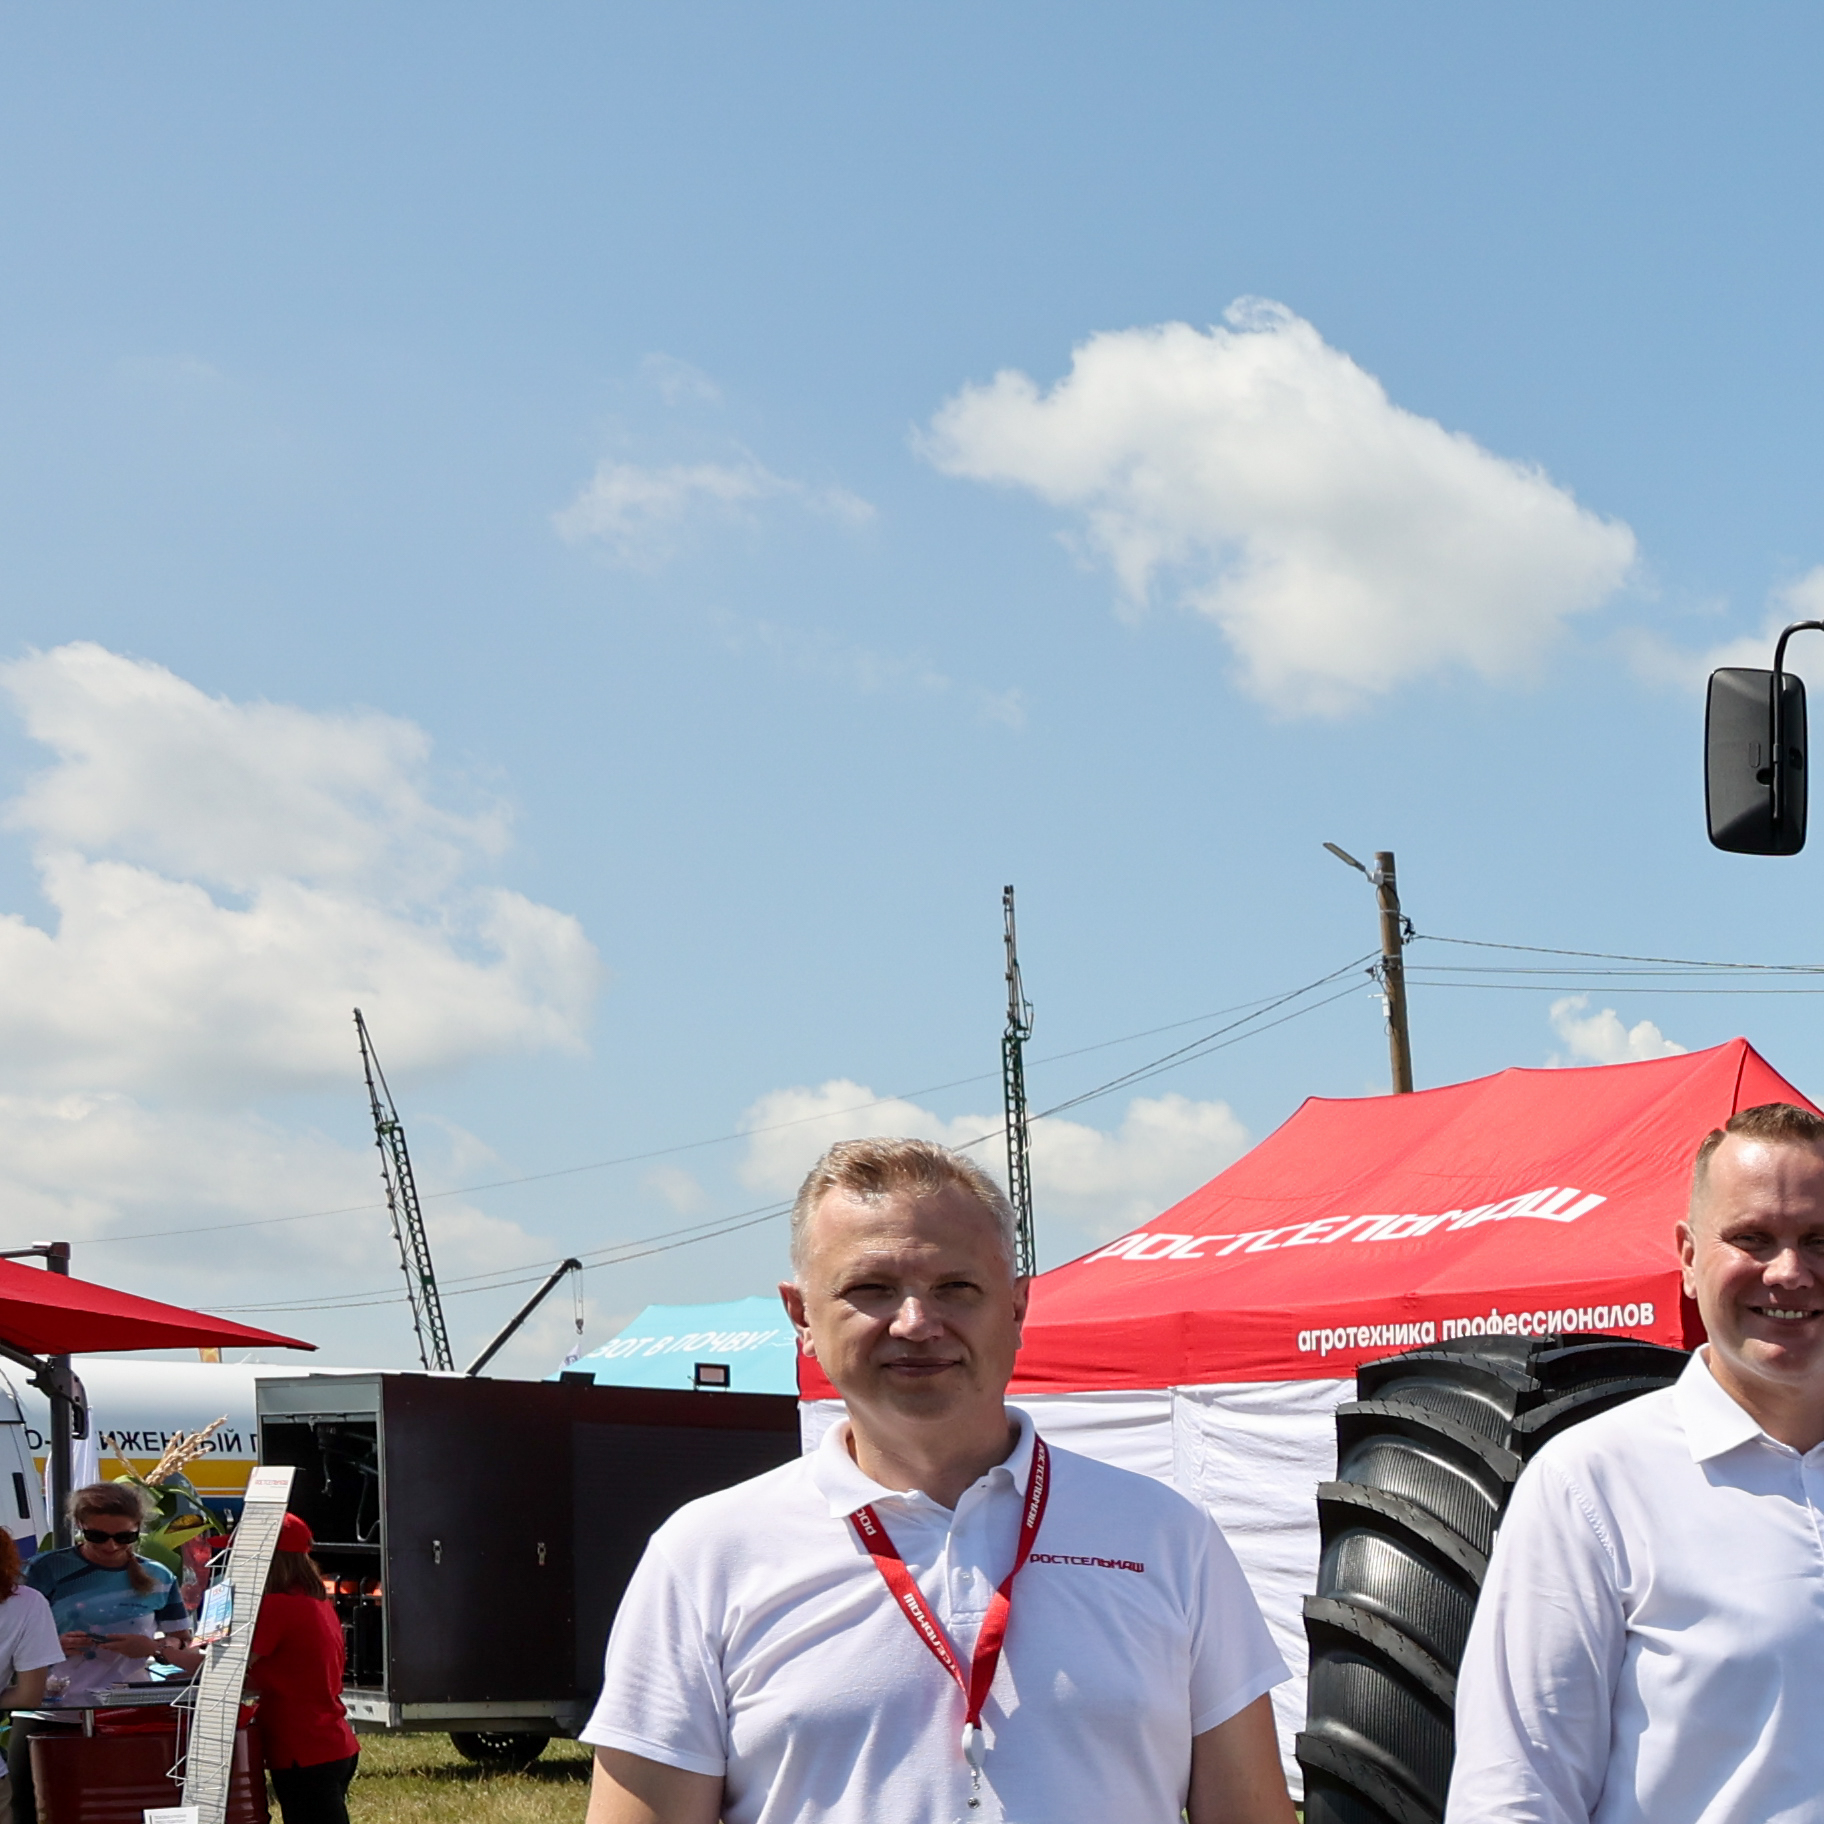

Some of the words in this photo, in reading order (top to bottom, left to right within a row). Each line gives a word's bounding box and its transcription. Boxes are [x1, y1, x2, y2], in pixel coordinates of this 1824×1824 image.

[1083, 1186, 1608, 1265] РОСТСЕЛЬМАШ
[641, 1336, 670, 1357] В
[668, 1329, 780, 1353] ПОЧВУ!
[1298, 1319, 1436, 1357] агротехника
[1442, 1302, 1655, 1342] профессионалов
[1030, 1553, 1144, 1573] РОСТСЕЛЬМАШ
